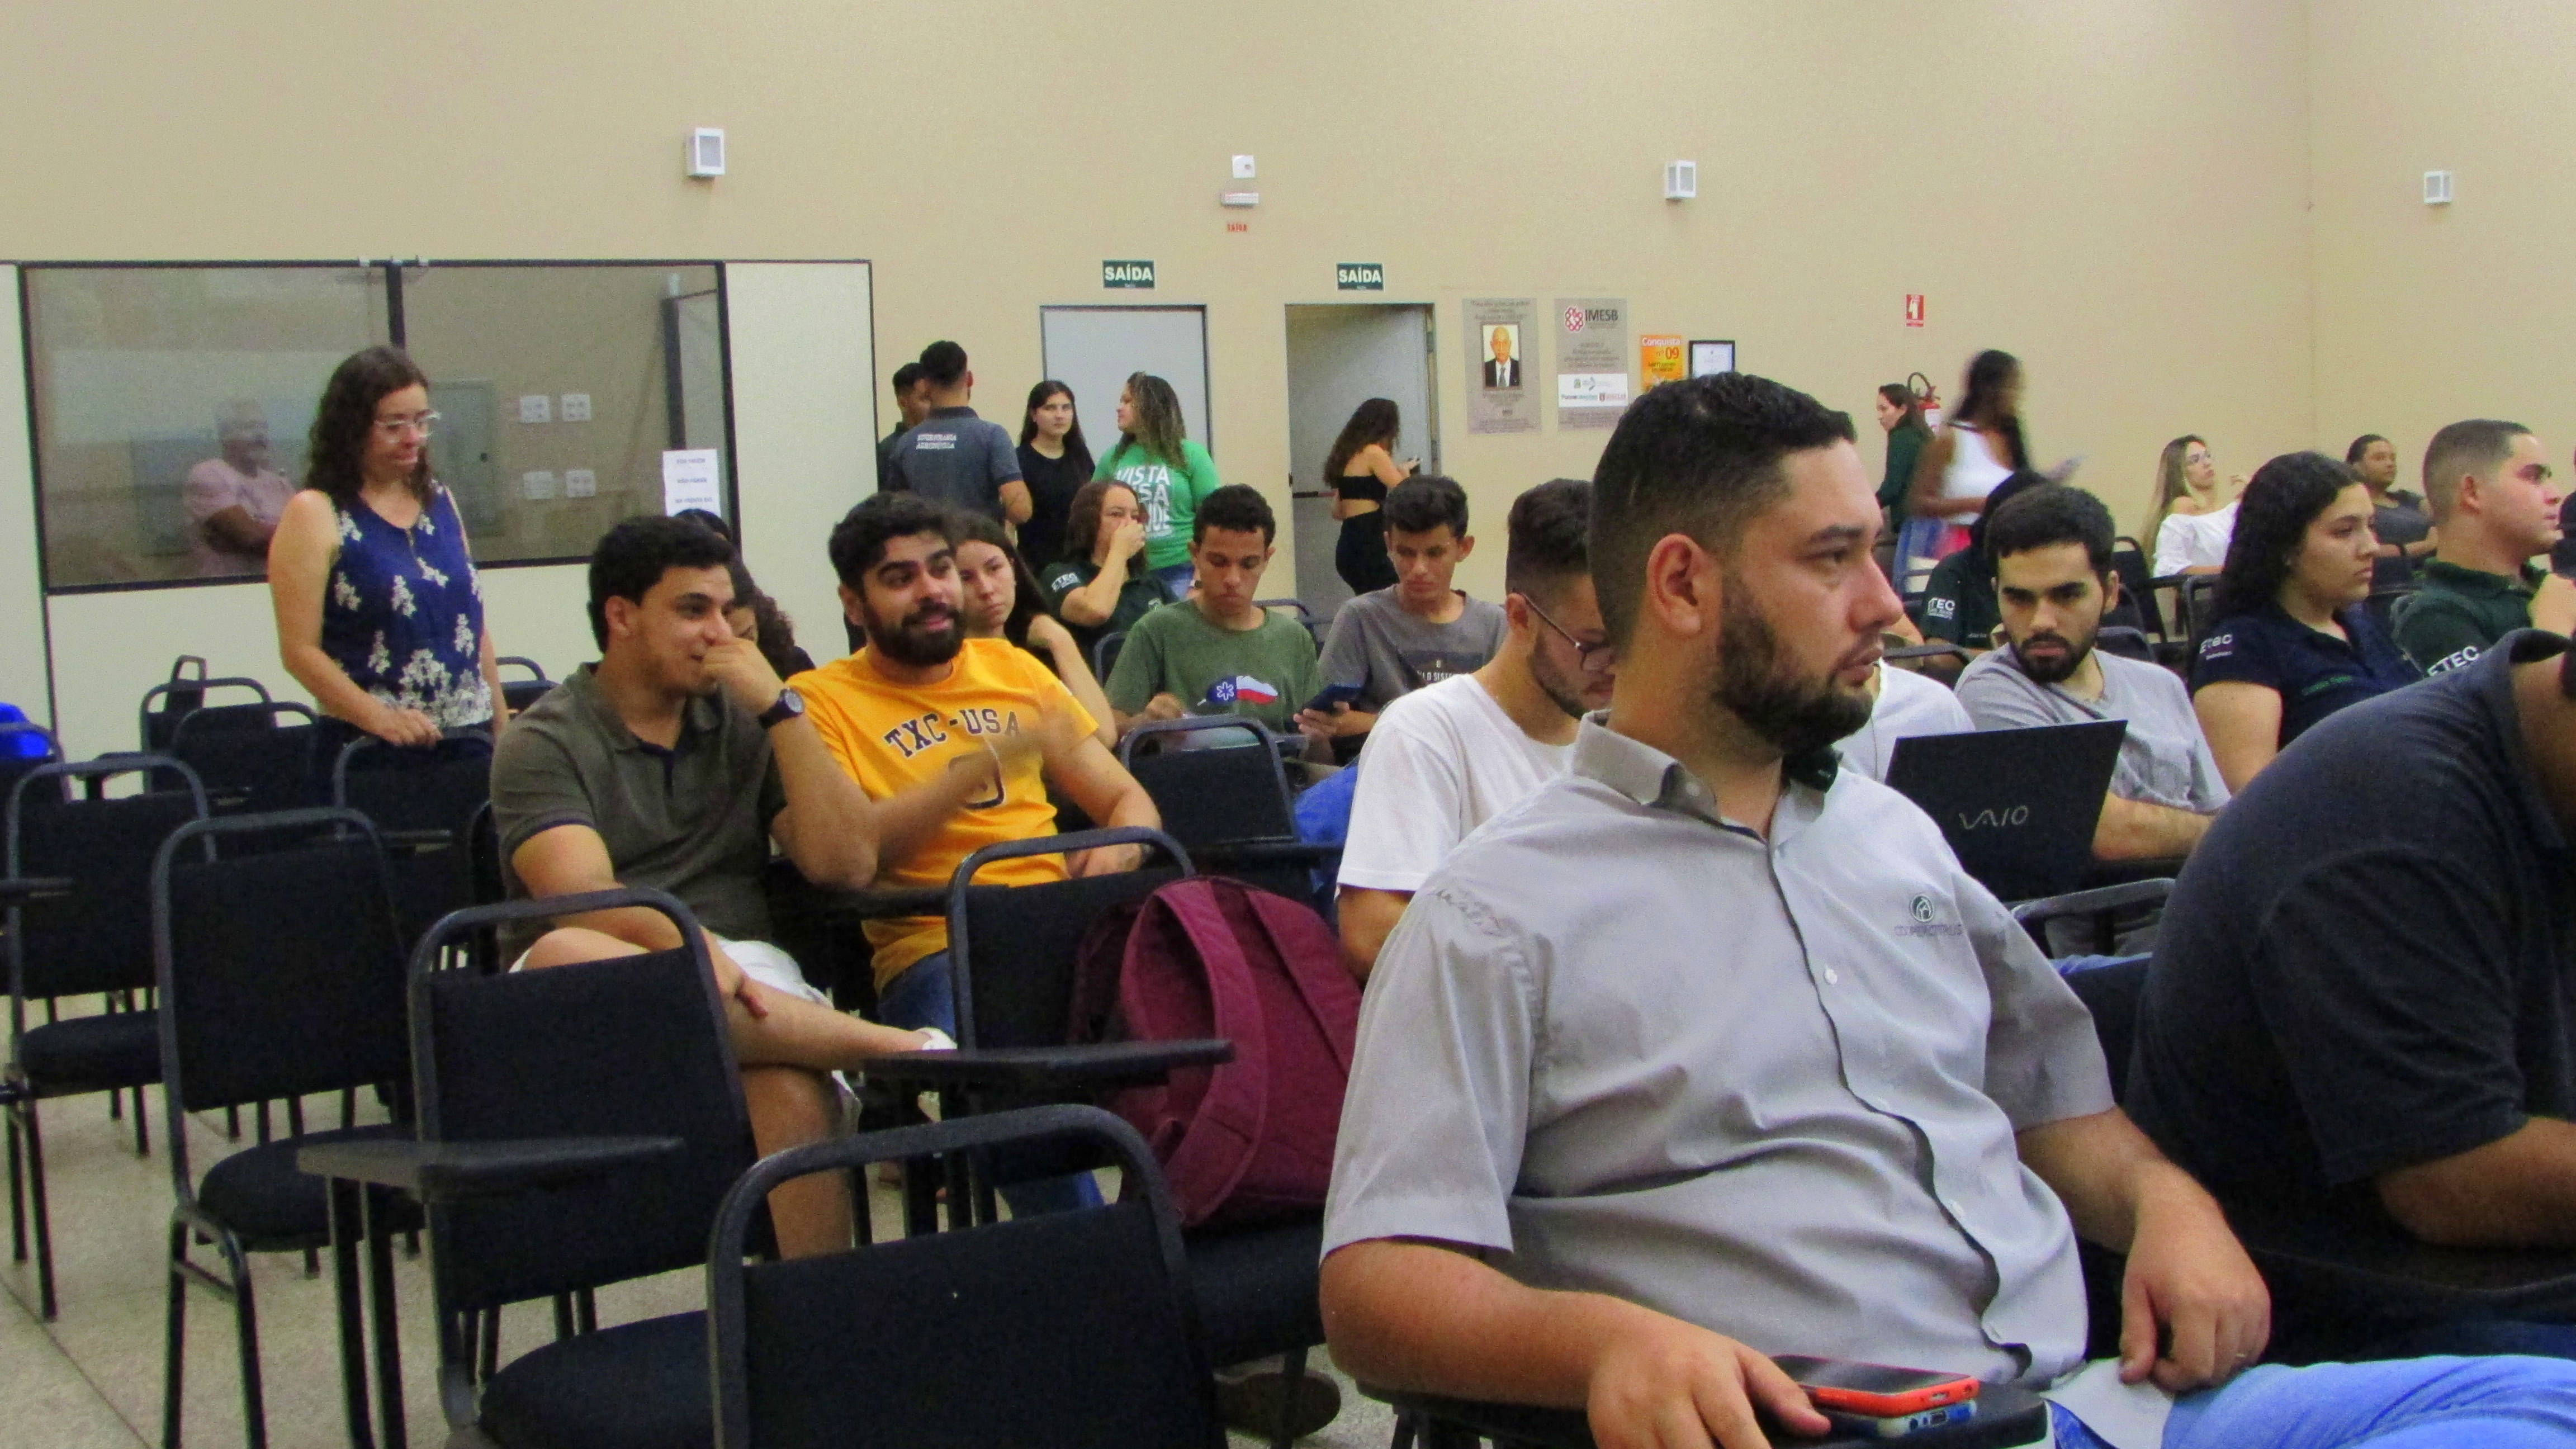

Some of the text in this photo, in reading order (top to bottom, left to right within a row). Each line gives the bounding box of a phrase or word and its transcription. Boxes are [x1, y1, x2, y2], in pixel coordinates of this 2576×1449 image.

[1105, 264, 1153, 281] SAÍDA
[1339, 267, 1381, 283] SAÍDA
[1585, 309, 1618, 321] IMESB
[1642, 337, 1681, 347] Conquista
[1665, 347, 1679, 359] 09
[1114, 465, 1171, 485] VISTA
[2427, 646, 2481, 677] ETEC
[883, 708, 1020, 758] TXC-USA
[1958, 805, 2028, 830] VAIO
